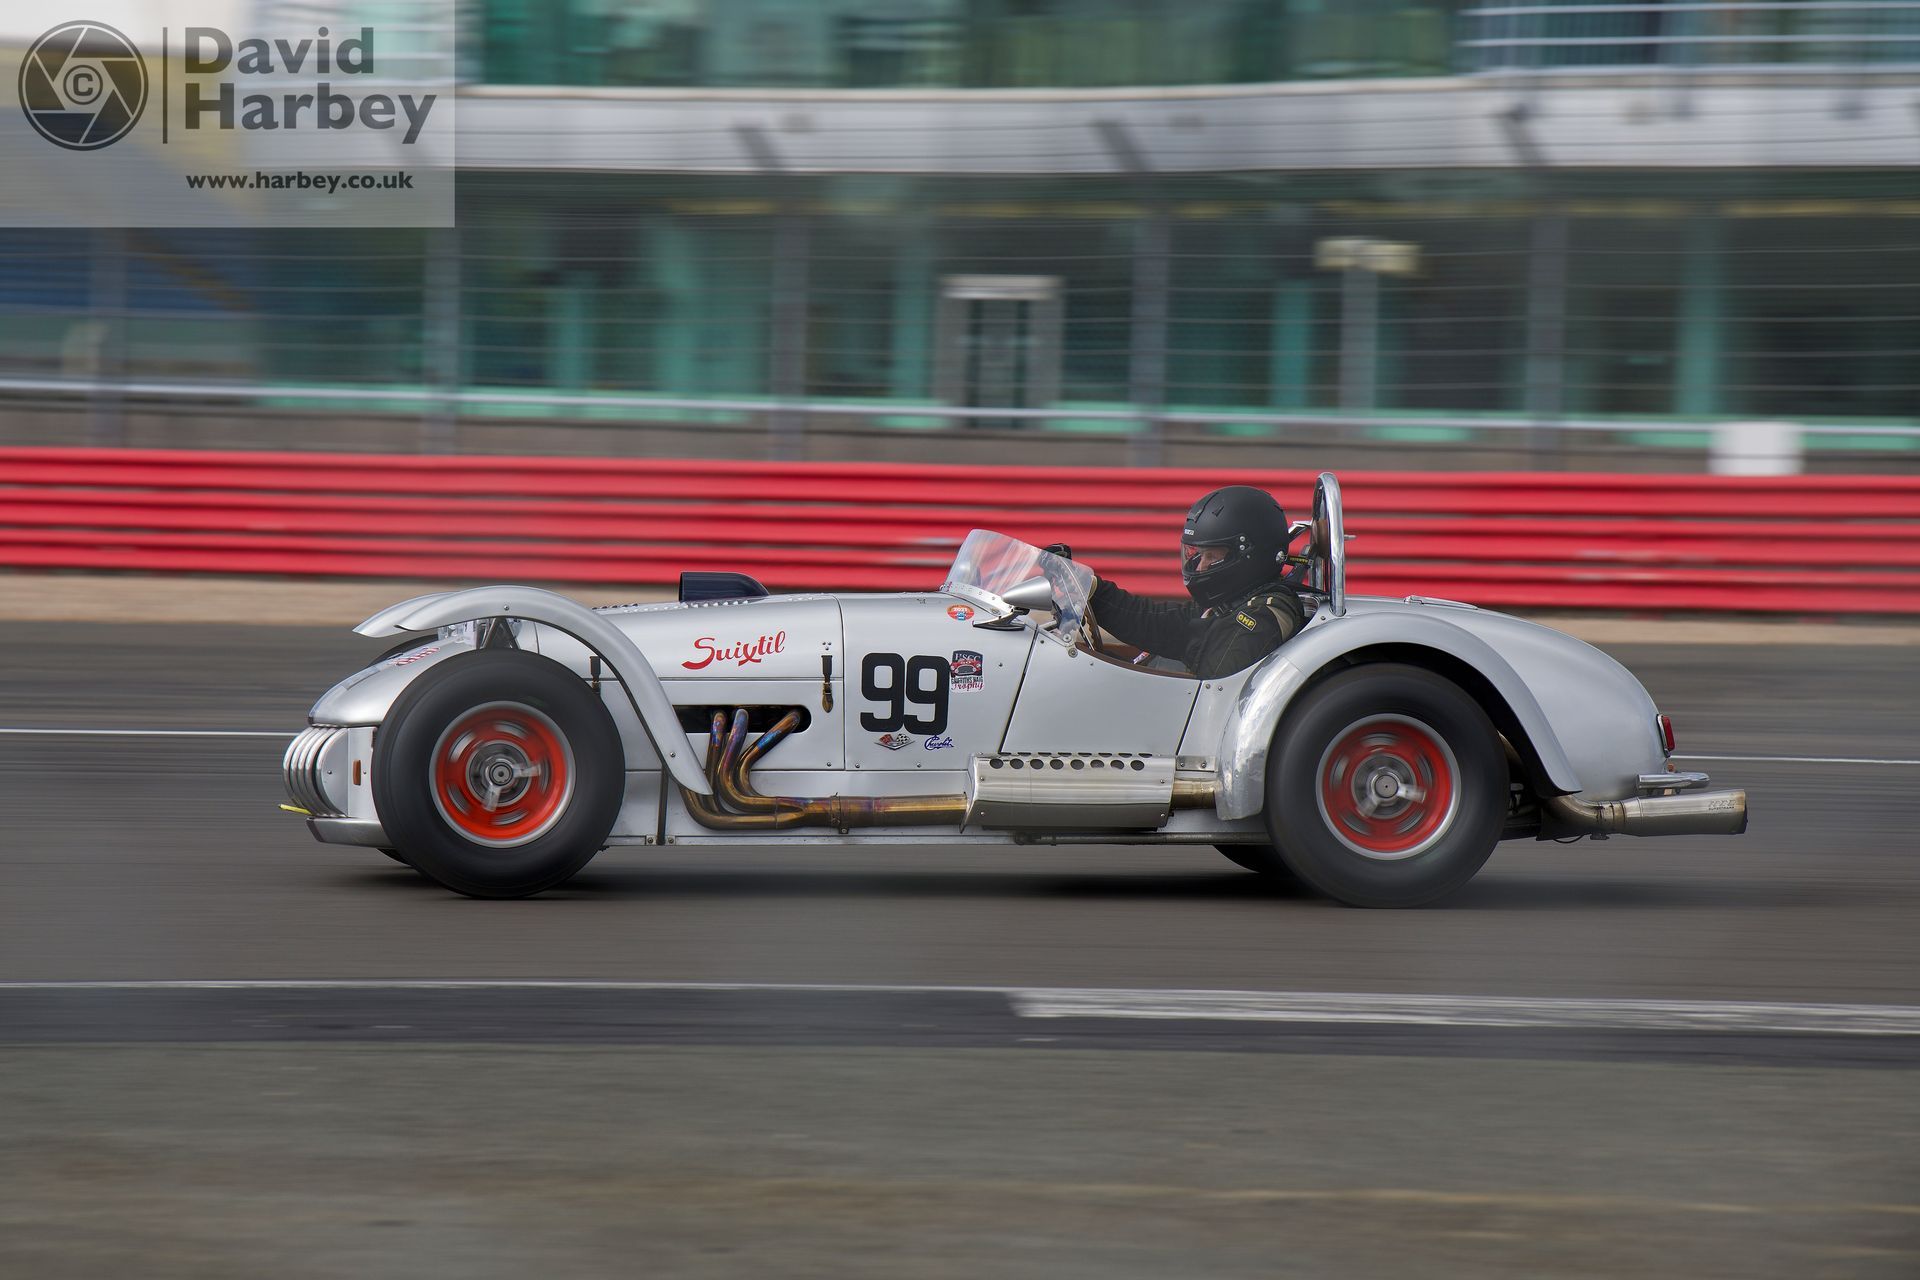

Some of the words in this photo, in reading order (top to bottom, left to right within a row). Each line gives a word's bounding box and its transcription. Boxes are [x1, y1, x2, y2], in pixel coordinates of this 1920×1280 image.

[1238, 614, 1255, 628] OMP
[681, 631, 786, 670] Suixtil
[860, 652, 949, 735] 99
[951, 681, 985, 691] Trophy
